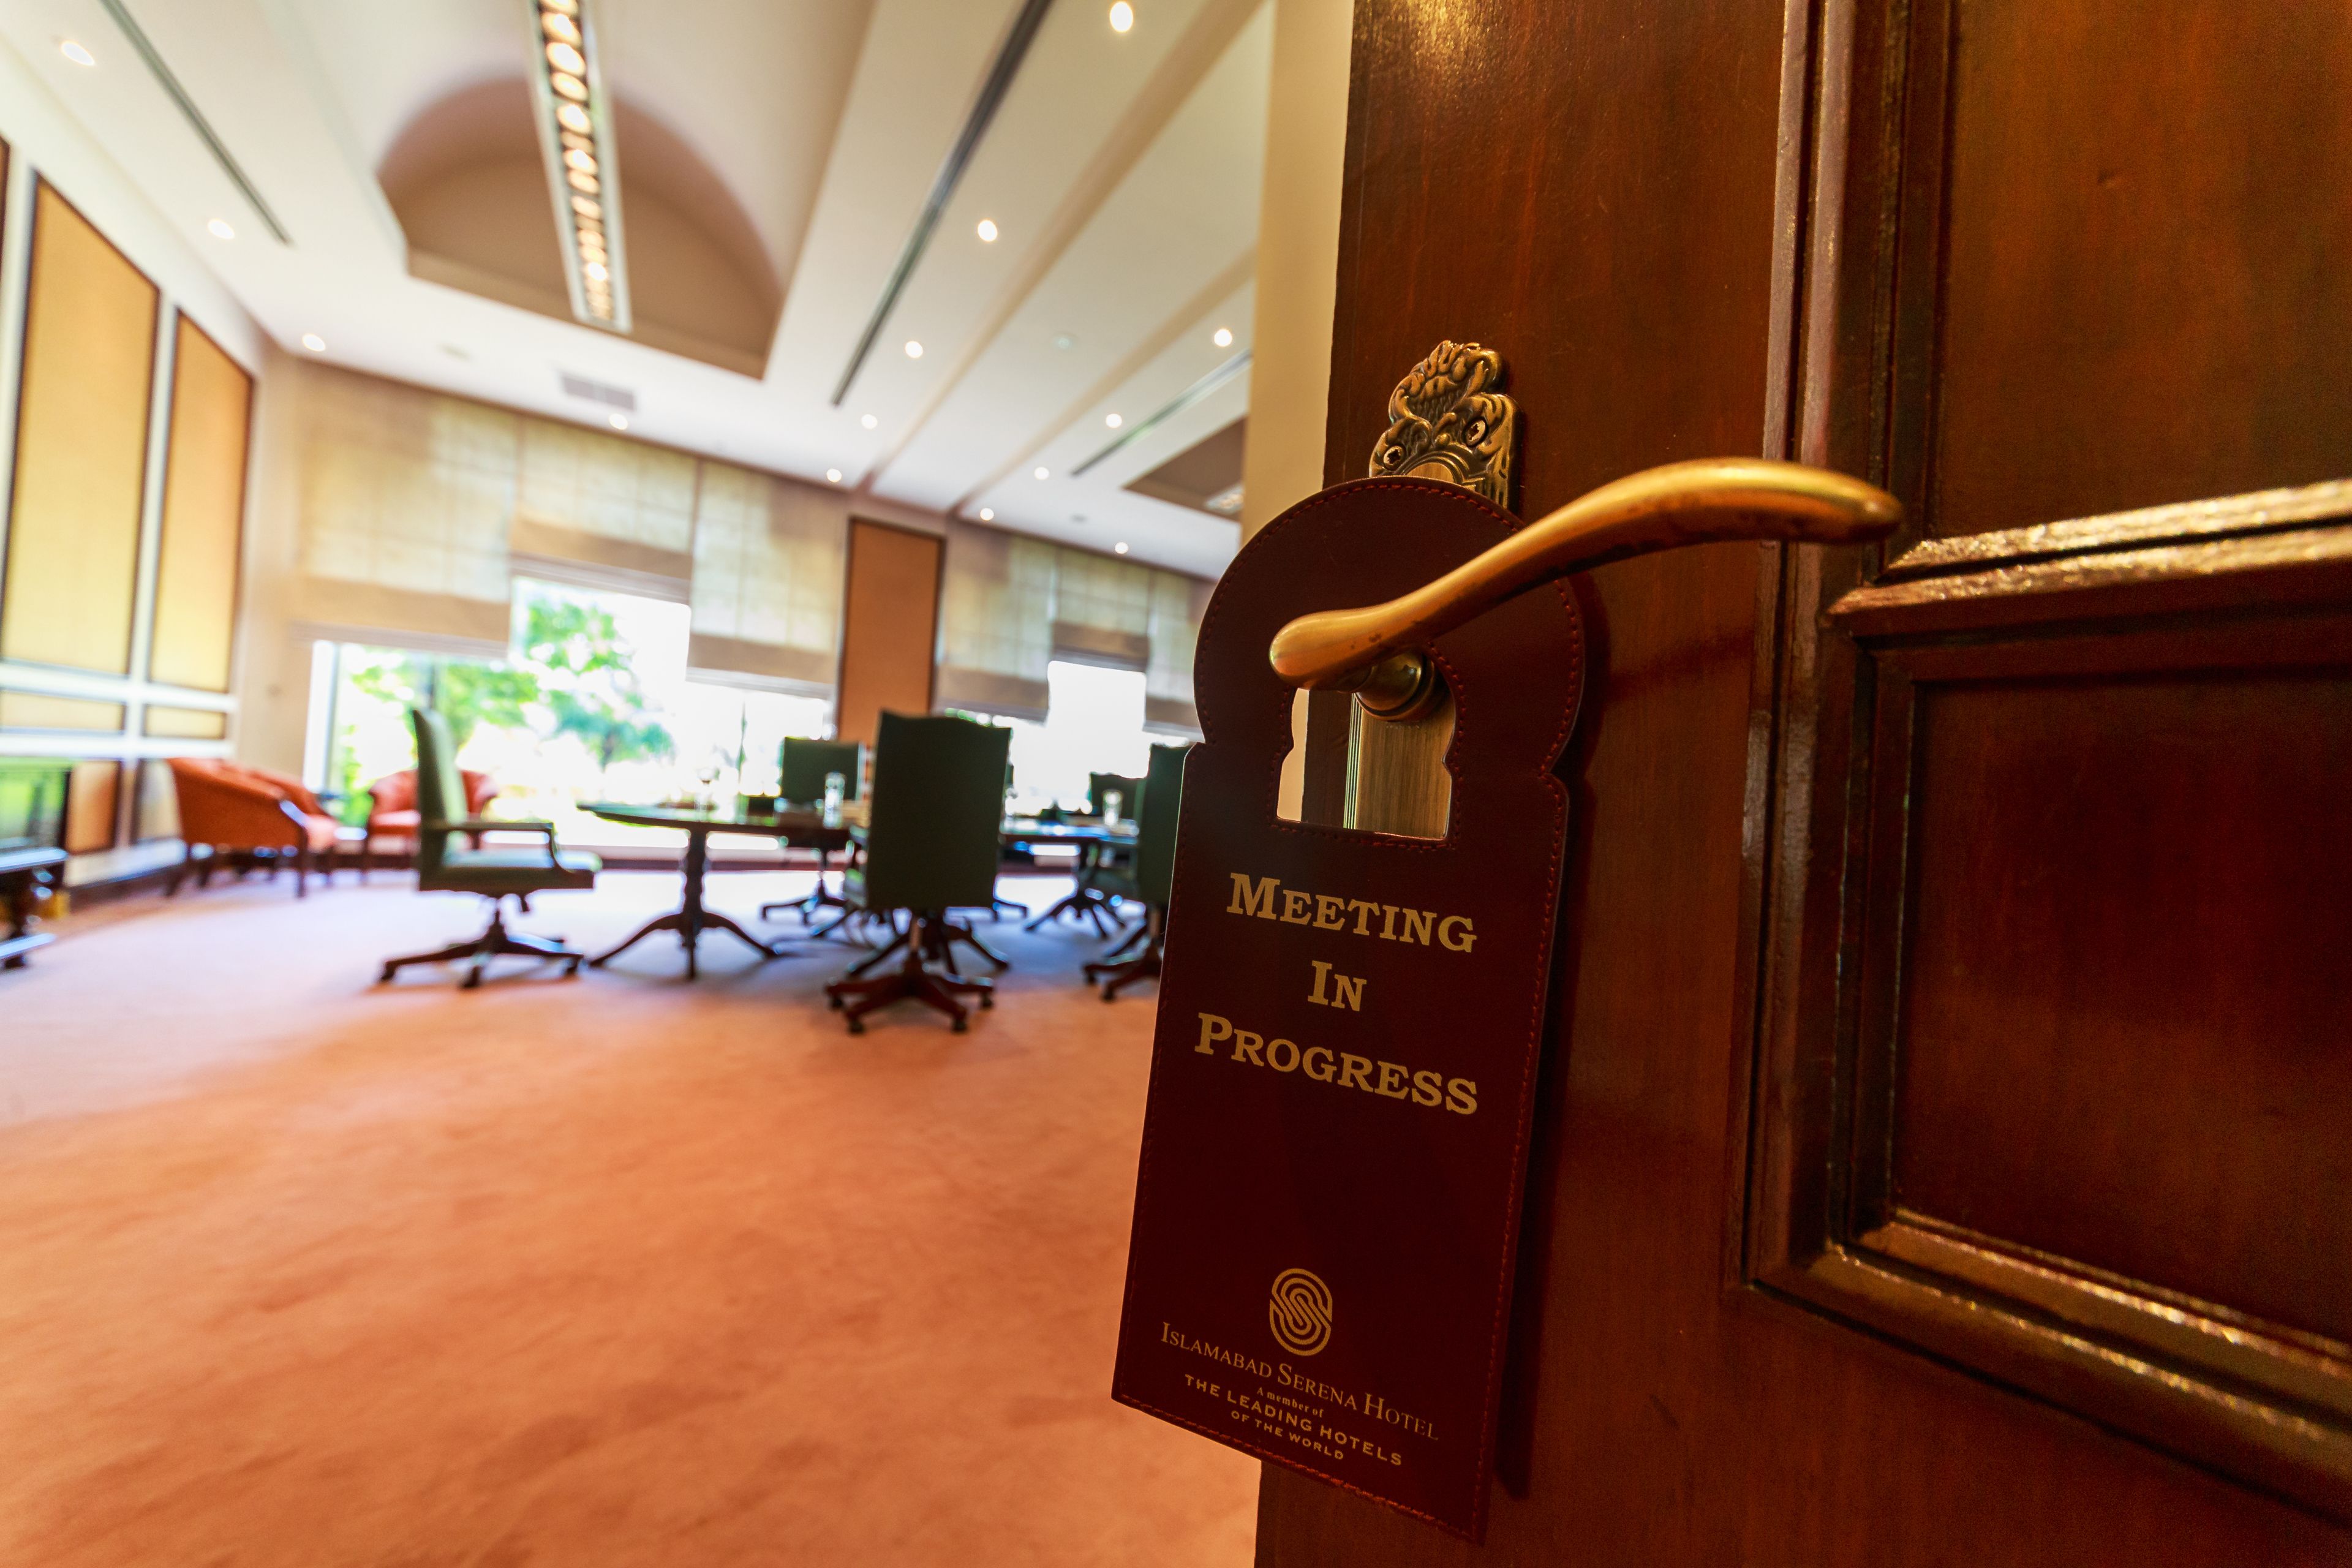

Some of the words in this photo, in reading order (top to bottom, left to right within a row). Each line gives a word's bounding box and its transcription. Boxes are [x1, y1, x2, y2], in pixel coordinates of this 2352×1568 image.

[1185, 1373, 1220, 1397] THE
[1227, 1390, 1312, 1431] LEADING
[1320, 1425, 1401, 1466] HOTELS
[1257, 1387, 1264, 1396] A
[1267, 1391, 1310, 1412] member
[1313, 1408, 1324, 1418] of
[1231, 1411, 1250, 1422] OF
[1255, 1419, 1283, 1437] THE
[1289, 1432, 1344, 1460] WORLD
